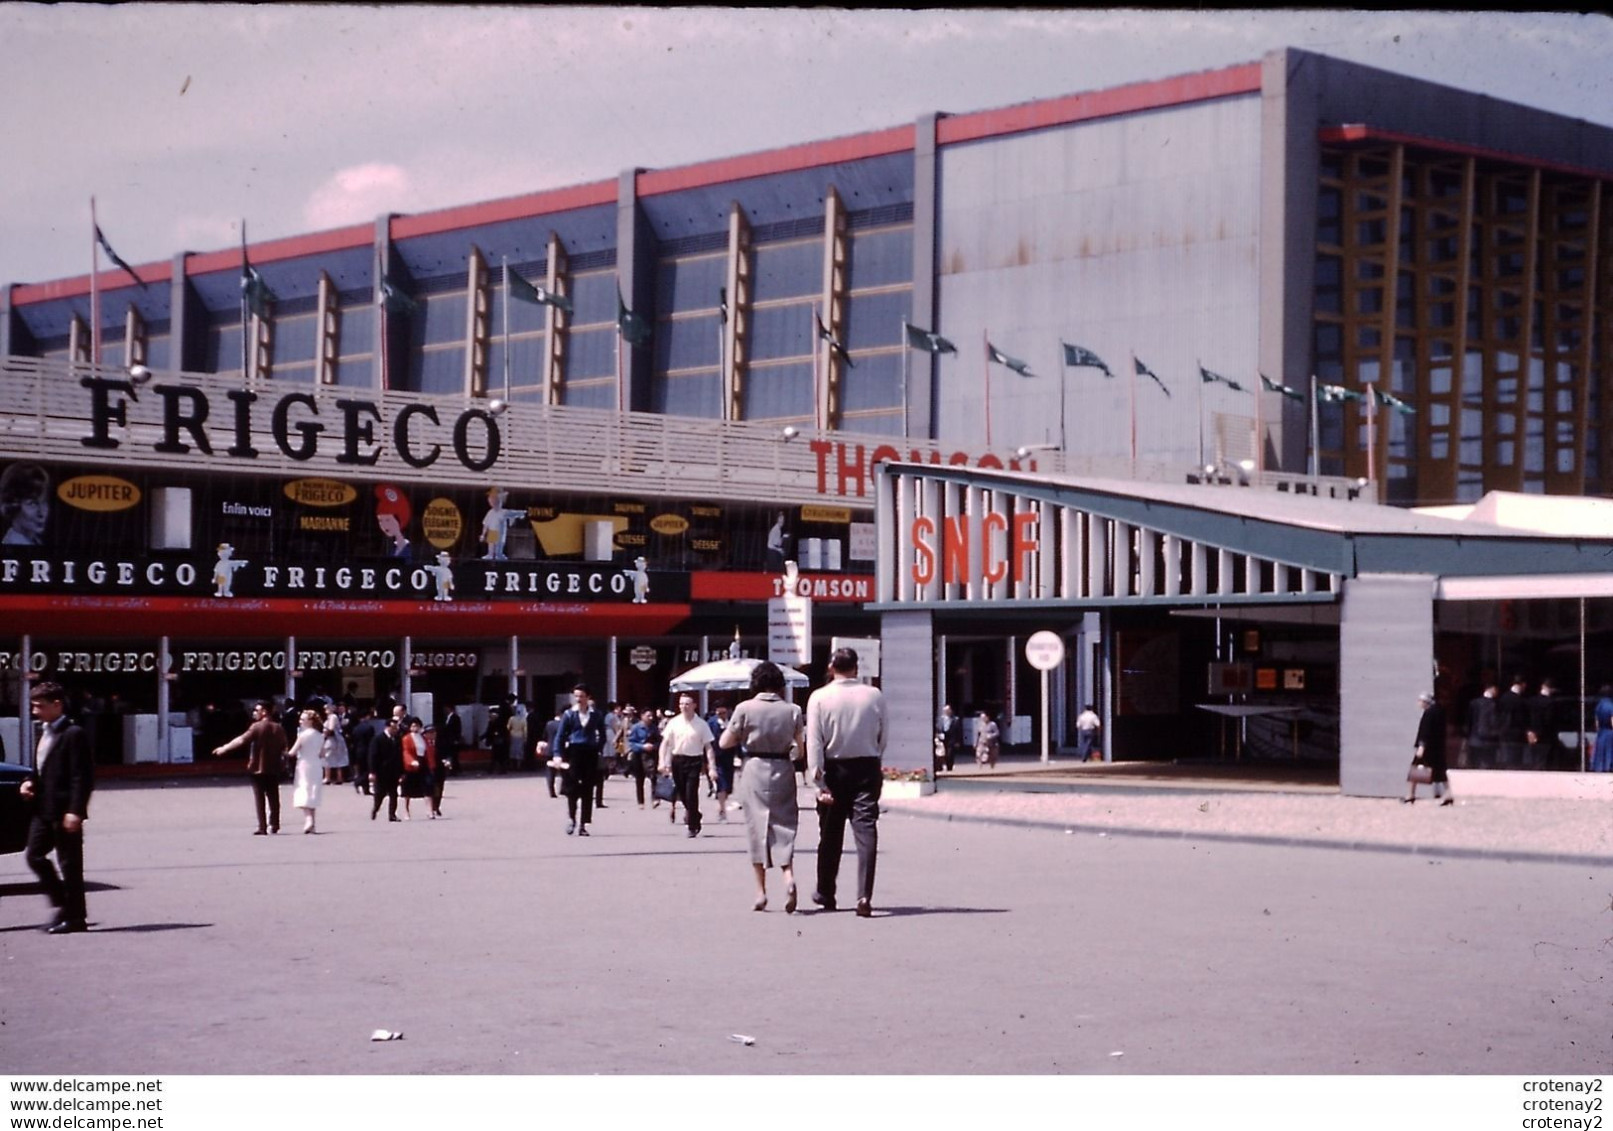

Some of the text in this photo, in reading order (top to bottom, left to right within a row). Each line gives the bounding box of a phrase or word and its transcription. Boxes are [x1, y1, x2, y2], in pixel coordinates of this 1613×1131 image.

[80, 376, 501, 471] FRIGECO
[66, 482, 132, 501] JUPITER
[294, 487, 344, 502] FRIGECO
[222, 501, 247, 515] Enfin
[300, 516, 350, 531] MARIANNE
[912, 511, 1039, 585] SNCF
[2, 560, 196, 586] FRIGECO
[263, 566, 428, 590] FRIGECO
[484, 571, 626, 593] FRIGECO
[773, 578, 868, 597] TOMSON
[182, 652, 287, 670] FRIGECO
[296, 650, 395, 669] FRIGECO
